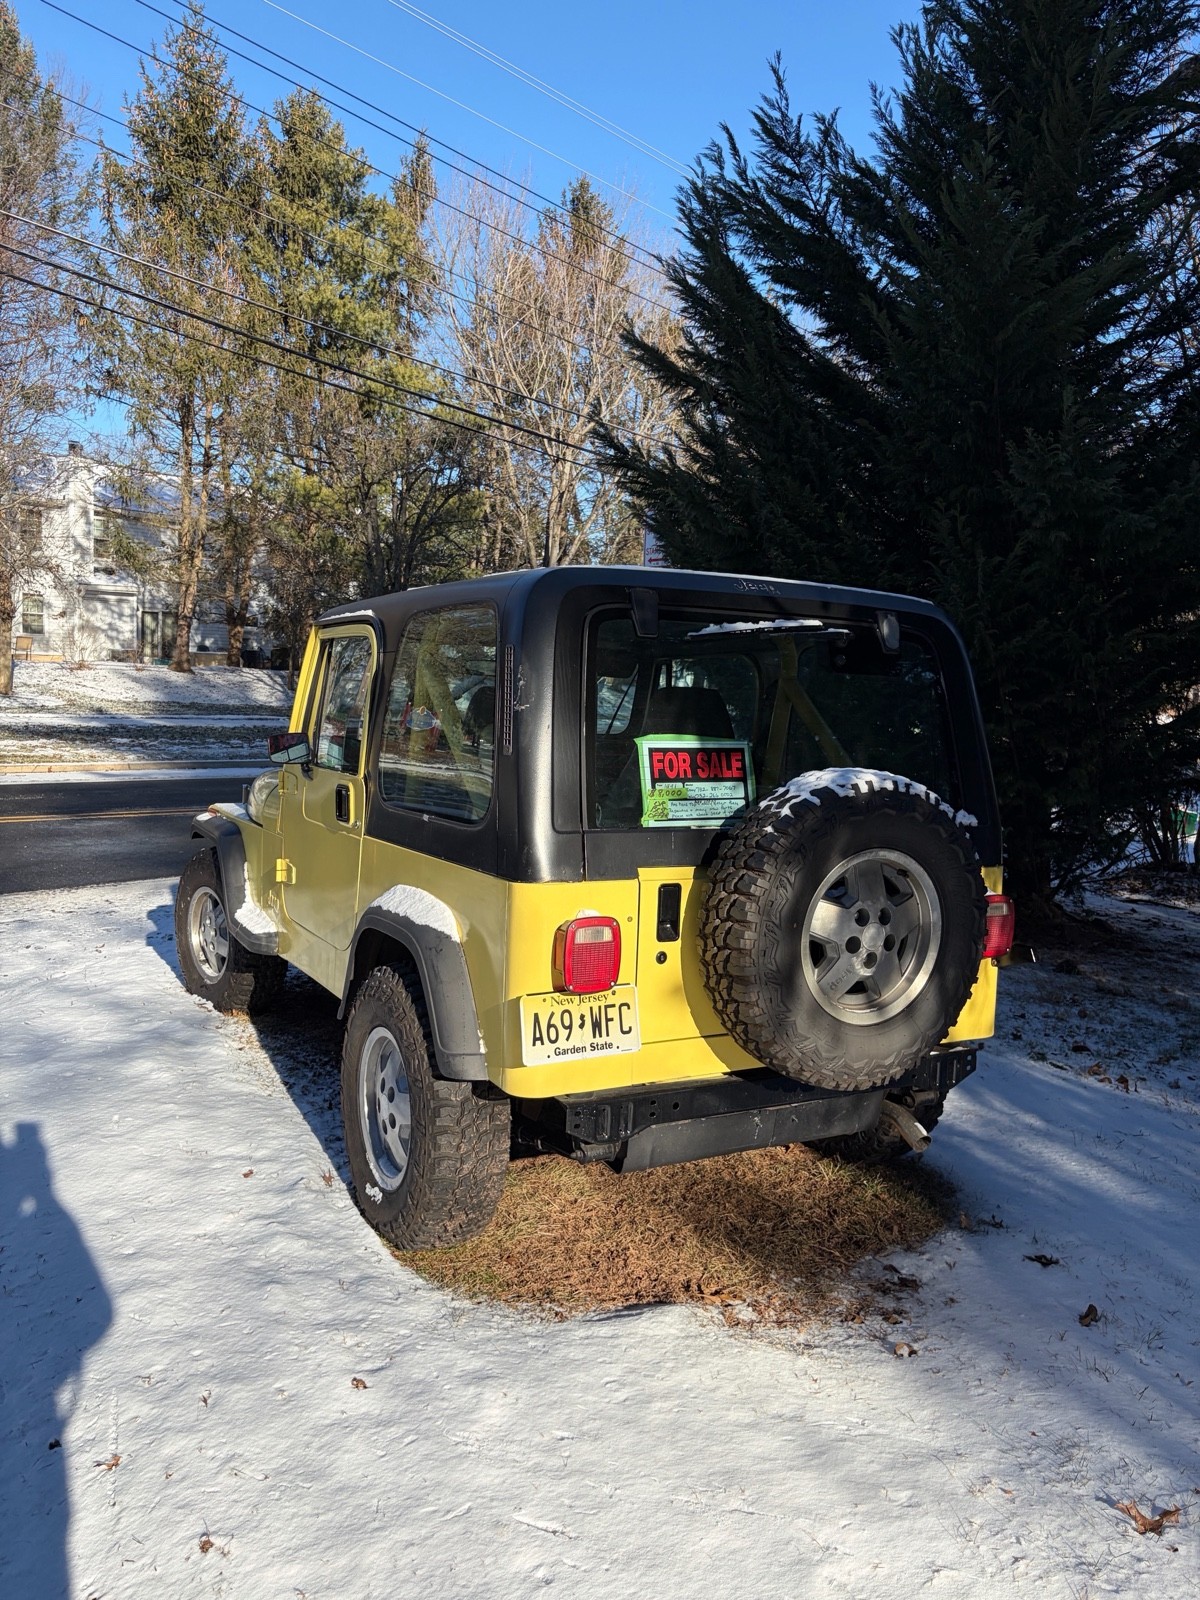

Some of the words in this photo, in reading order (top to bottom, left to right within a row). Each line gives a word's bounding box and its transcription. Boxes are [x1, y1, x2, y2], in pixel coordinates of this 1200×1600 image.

[652, 752, 692, 779] FOR
[696, 752, 744, 779] SALE
[550, 995, 577, 1007] New
[577, 992, 610, 1006] Jersey
[532, 1008, 573, 1047] A69
[589, 1002, 633, 1039] WFC
[554, 1043, 587, 1057] Garden
[589, 1041, 614, 1052] State
